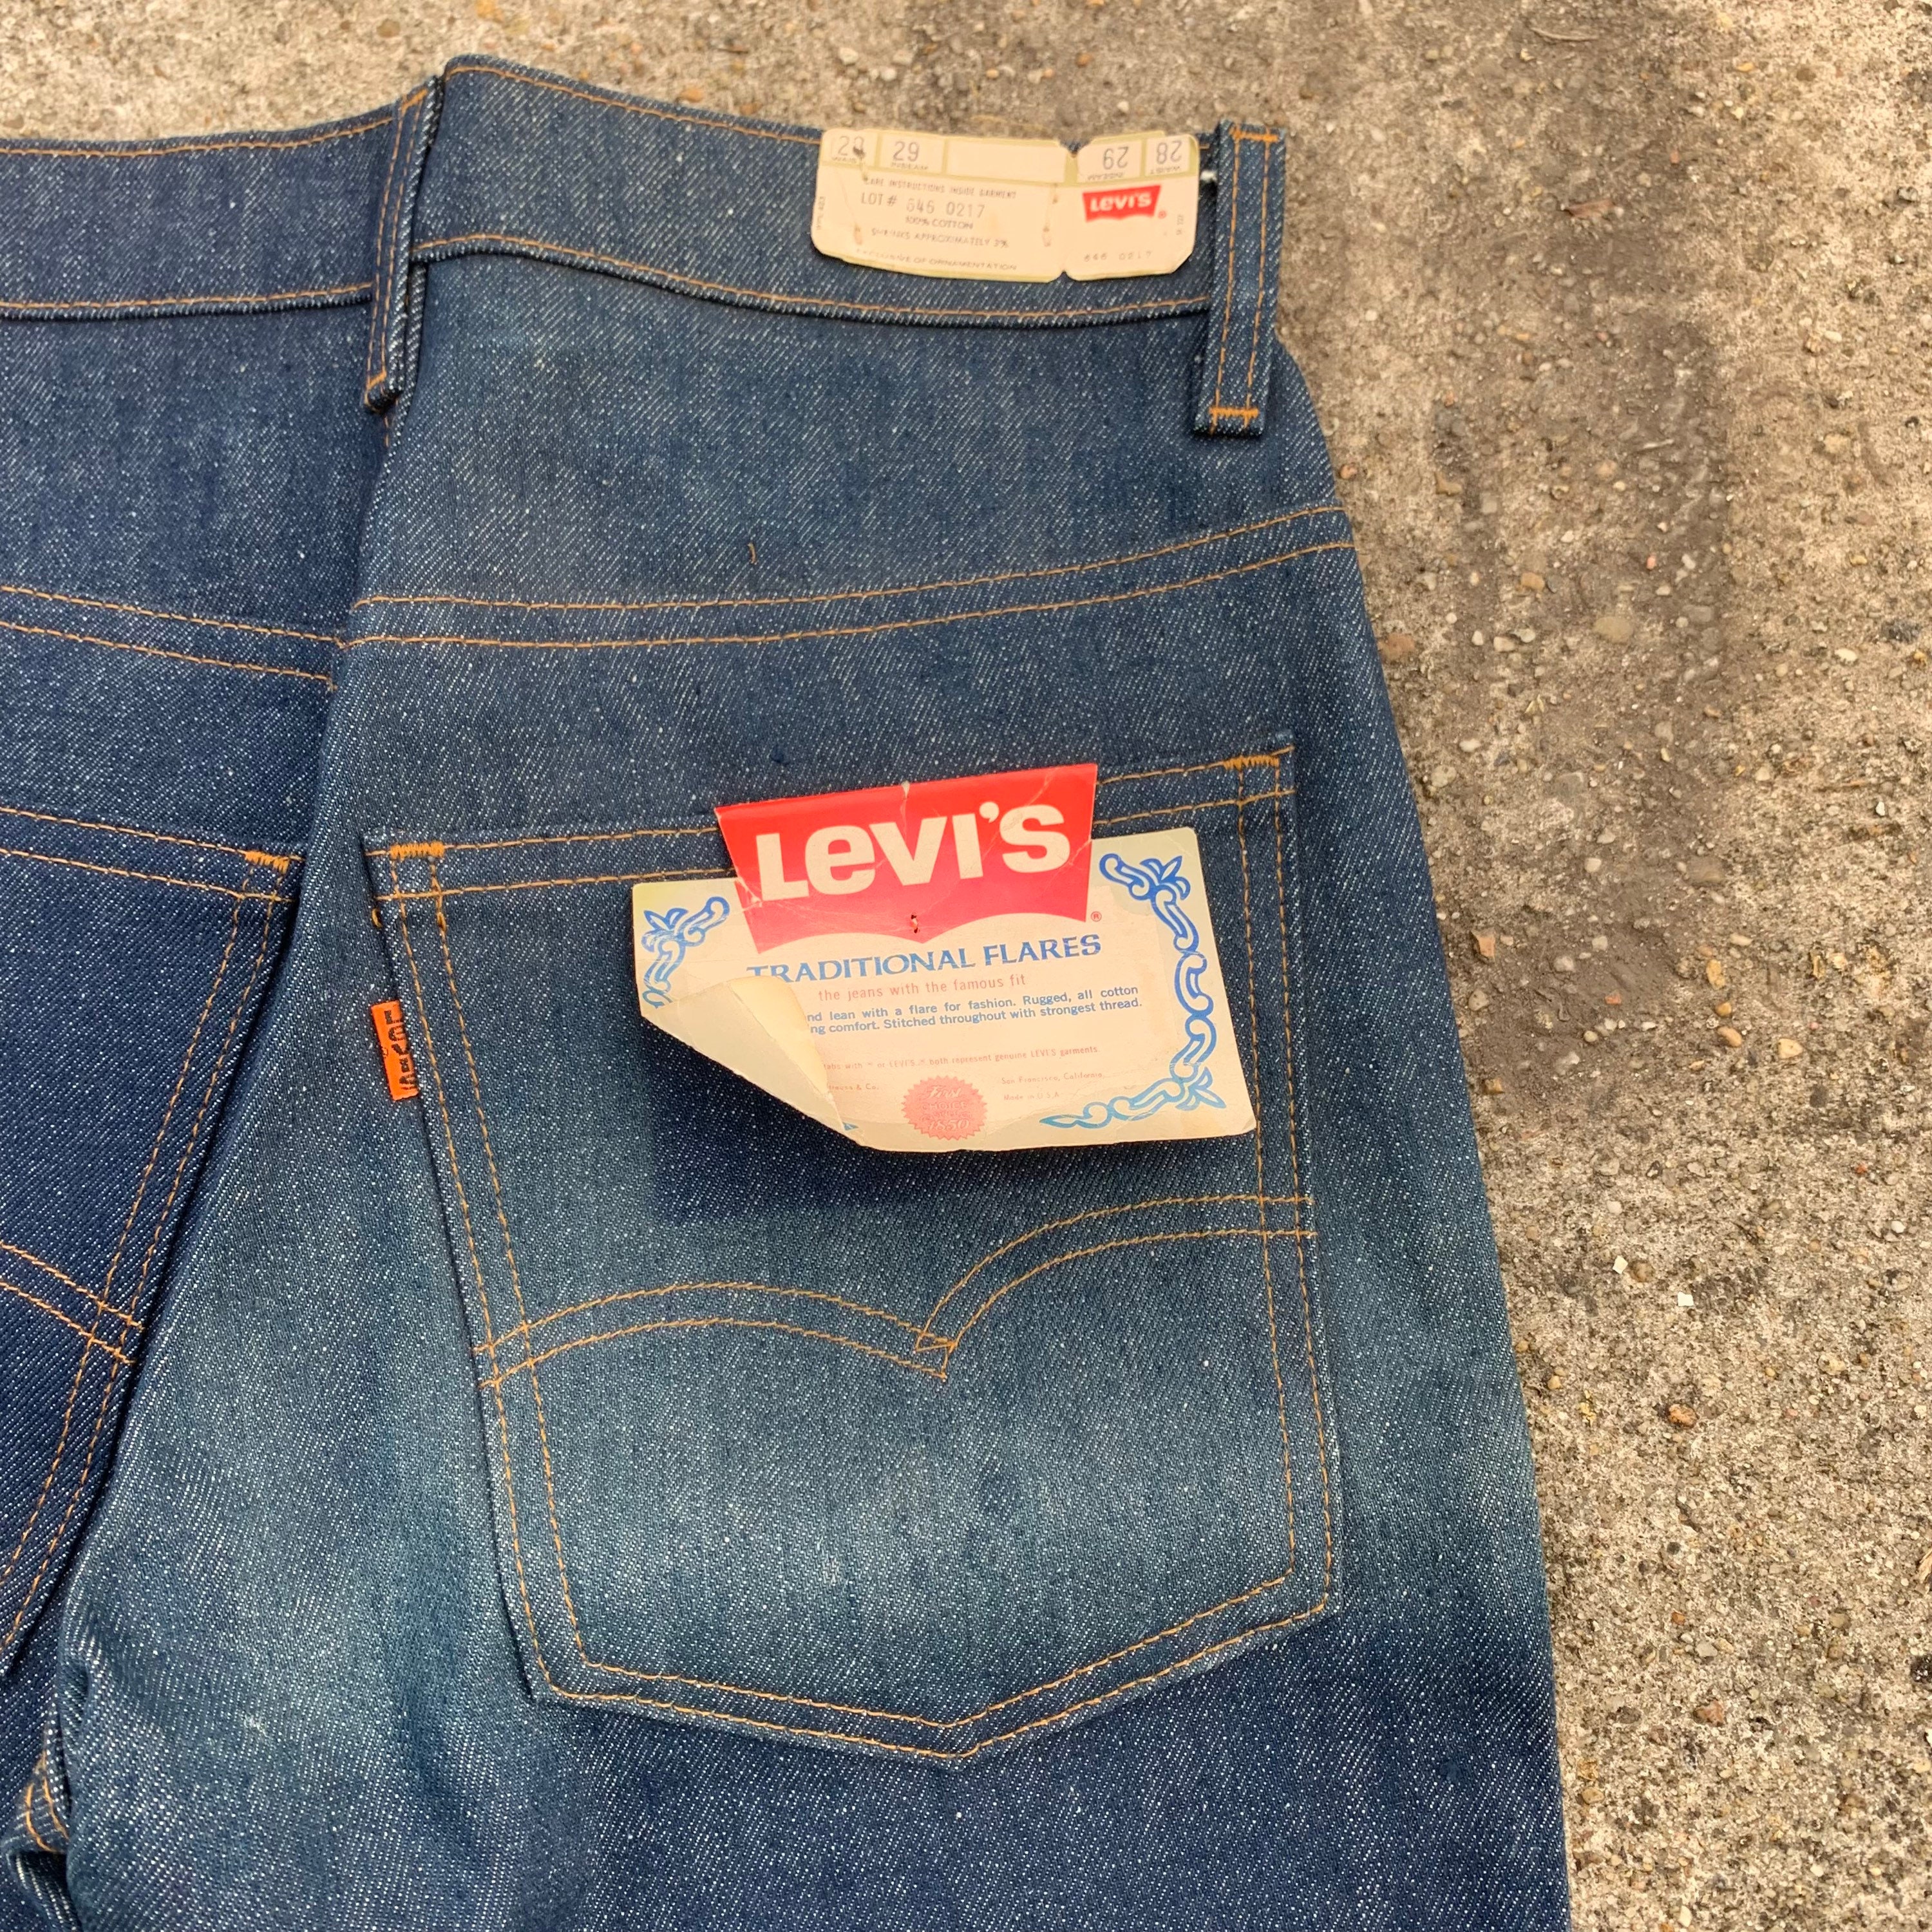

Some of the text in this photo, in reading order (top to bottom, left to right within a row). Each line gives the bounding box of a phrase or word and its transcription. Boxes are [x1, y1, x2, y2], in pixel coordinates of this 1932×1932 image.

[893, 140, 920, 162] 29
[1103, 146, 1130, 170] 29
[1157, 140, 1182, 164] 28
[861, 193, 884, 206] LOT
[887, 194, 898, 206] #
[946, 201, 985, 218] 0217
[932, 218, 974, 229] COTTON
[746, 934, 1101, 983] TRADITIONAL FLARES
[819, 974, 1026, 1001] the jeans with the famous fit
[807, 985, 1139, 1022] nd lean with a flare for fashion. Rugged, all cotton
[829, 1019, 880, 1034] comfort.
[884, 1016, 936, 1029] Stitched
[940, 1010, 1007, 1025] throughout
[1010, 1009, 1036, 1019] with
[1040, 1003, 1096, 1017] strongest
[1100, 998, 1142, 1012] thread.
[929, 1057, 948, 1066] both
[952, 1055, 992, 1065] represent
[995, 1052, 1027, 1062] genuine
